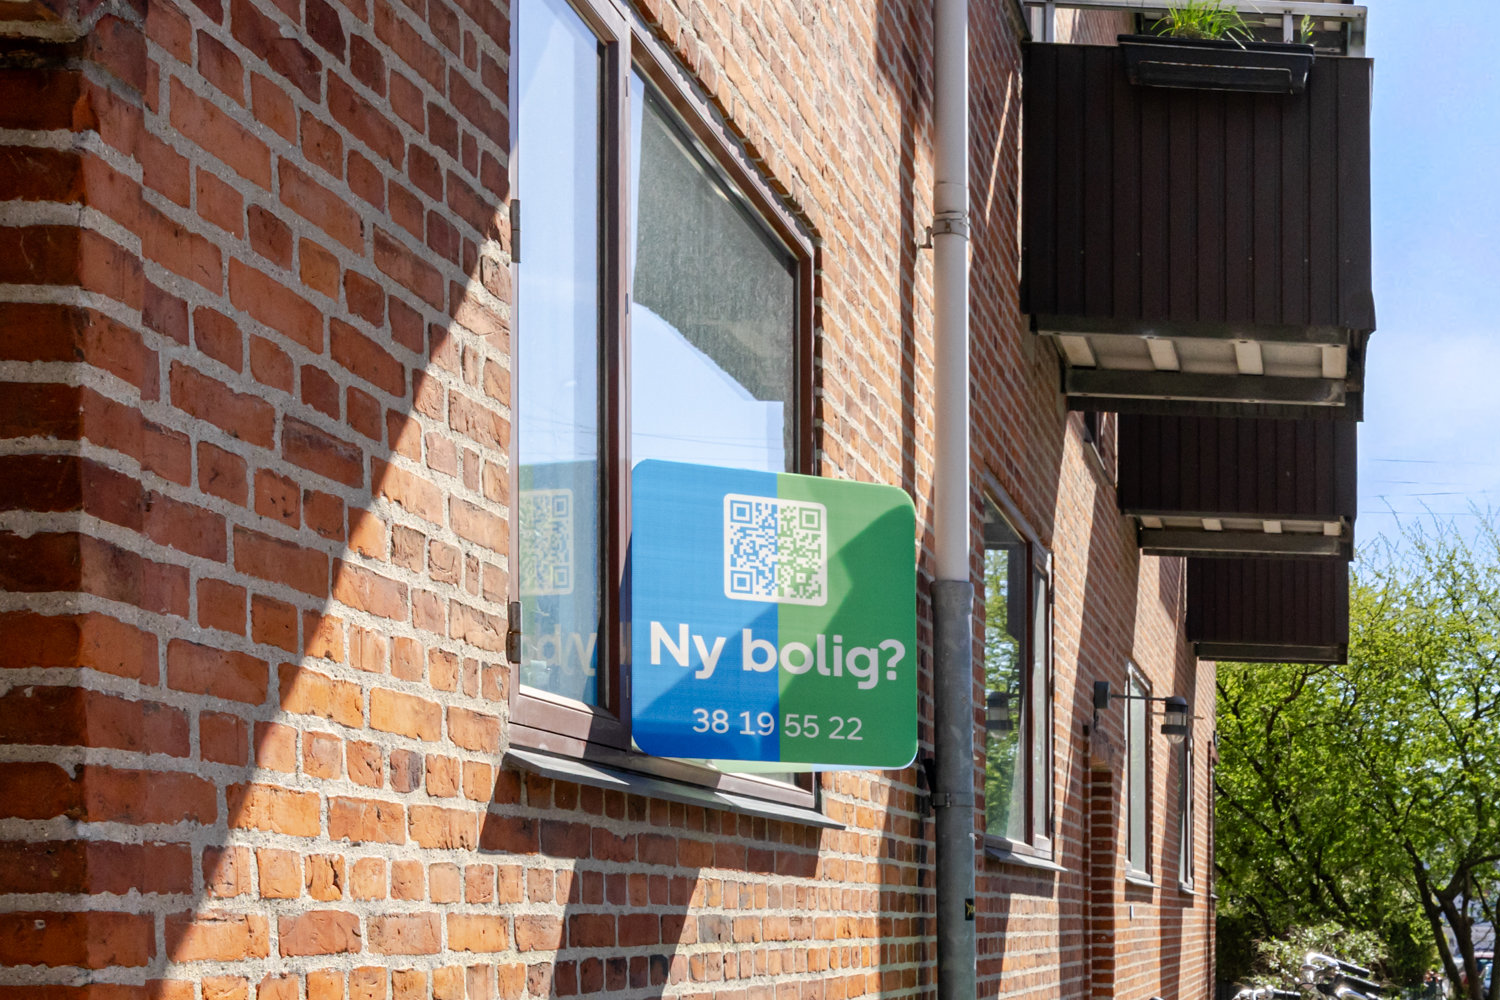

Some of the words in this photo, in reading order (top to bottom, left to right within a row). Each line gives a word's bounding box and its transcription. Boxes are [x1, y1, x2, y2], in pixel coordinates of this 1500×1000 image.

[651, 621, 727, 680] Ny
[742, 628, 906, 691] bolig?
[693, 708, 729, 734] 38
[740, 711, 775, 736] 19
[785, 713, 820, 738] 55
[829, 716, 863, 741] 22
